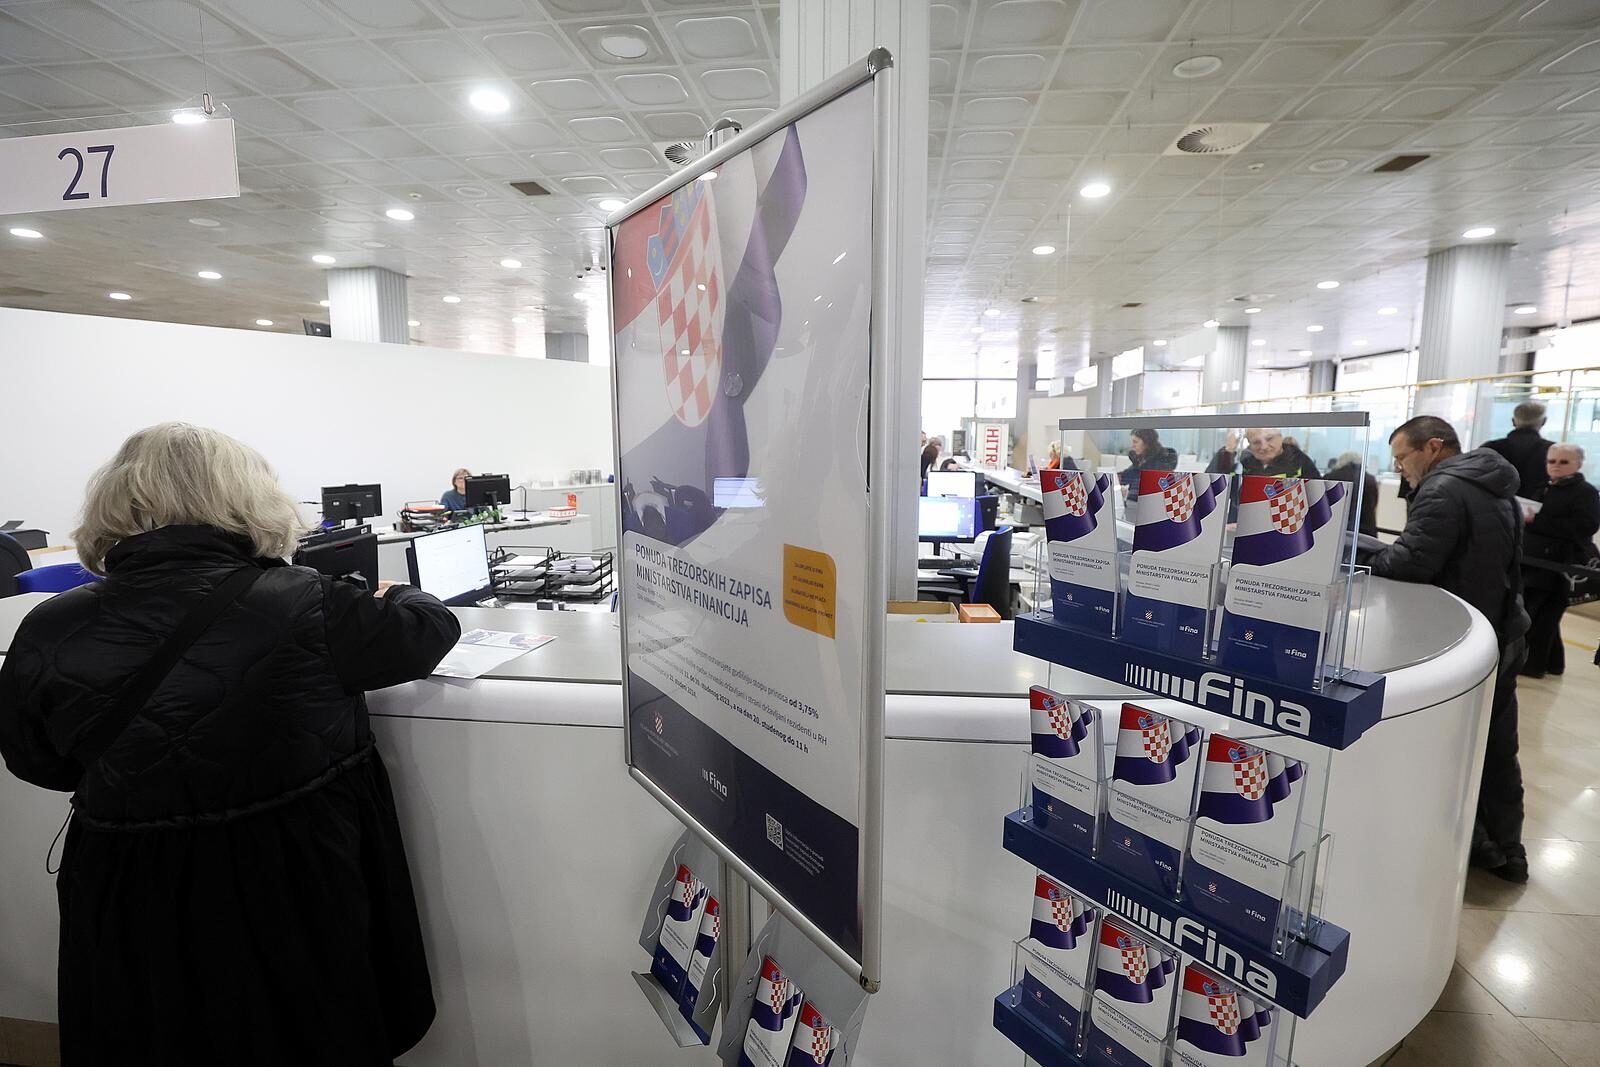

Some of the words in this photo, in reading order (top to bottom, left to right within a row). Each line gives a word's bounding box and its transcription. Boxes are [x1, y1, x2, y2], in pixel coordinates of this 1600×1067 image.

[58, 145, 115, 200] 27
[635, 543, 667, 569] PONUDA
[668, 556, 726, 592] TREZORSKIH
[729, 578, 772, 610] ZAPISA
[1135, 569, 1171, 580] MINISTARSTVA
[1171, 575, 1198, 584] FINANCIJA
[1136, 563, 1158, 571] PONUDA
[1158, 566, 1190, 576] TREZORSKIH
[1190, 571, 1209, 579] ZAPISA
[636, 563, 692, 602] MINISTARSTVA
[693, 589, 749, 627] FINANCIJA
[1235, 577, 1260, 588] PONUDA
[1261, 582, 1299, 594] TREZORSKIH
[1299, 588, 1321, 597] ZAPISA
[1235, 585, 1276, 598] MINISTARSTVA
[1276, 592, 1308, 603] FINANCIJA
[1184, 625, 1198, 634] Fina
[1291, 648, 1307, 659] Fina
[788, 698, 798, 708] od
[798, 700, 819, 719] 3,75%
[1198, 671, 1311, 737] Fina
[743, 707, 753, 720] dan
[753, 715, 761, 726] 20.
[761, 720, 787, 743] studenog
[787, 736, 795, 746] do
[796, 740, 803, 751] 11
[803, 743, 809, 754] h
[786, 716, 812, 738] rezidenti
[817, 733, 827, 745] RH
[707, 770, 728, 798] Fina
[1200, 836, 1238, 857] MINISTARSTVA
[1238, 853, 1268, 870] FINANCIJA
[1201, 830, 1224, 845] PONUDA
[1224, 840, 1259, 859] TREZORSKIH
[1259, 854, 1280, 868] ZAPISA
[1159, 860, 1172, 871] Fina
[1251, 910, 1266, 922] Fina
[1173, 915, 1278, 1000] Fina
